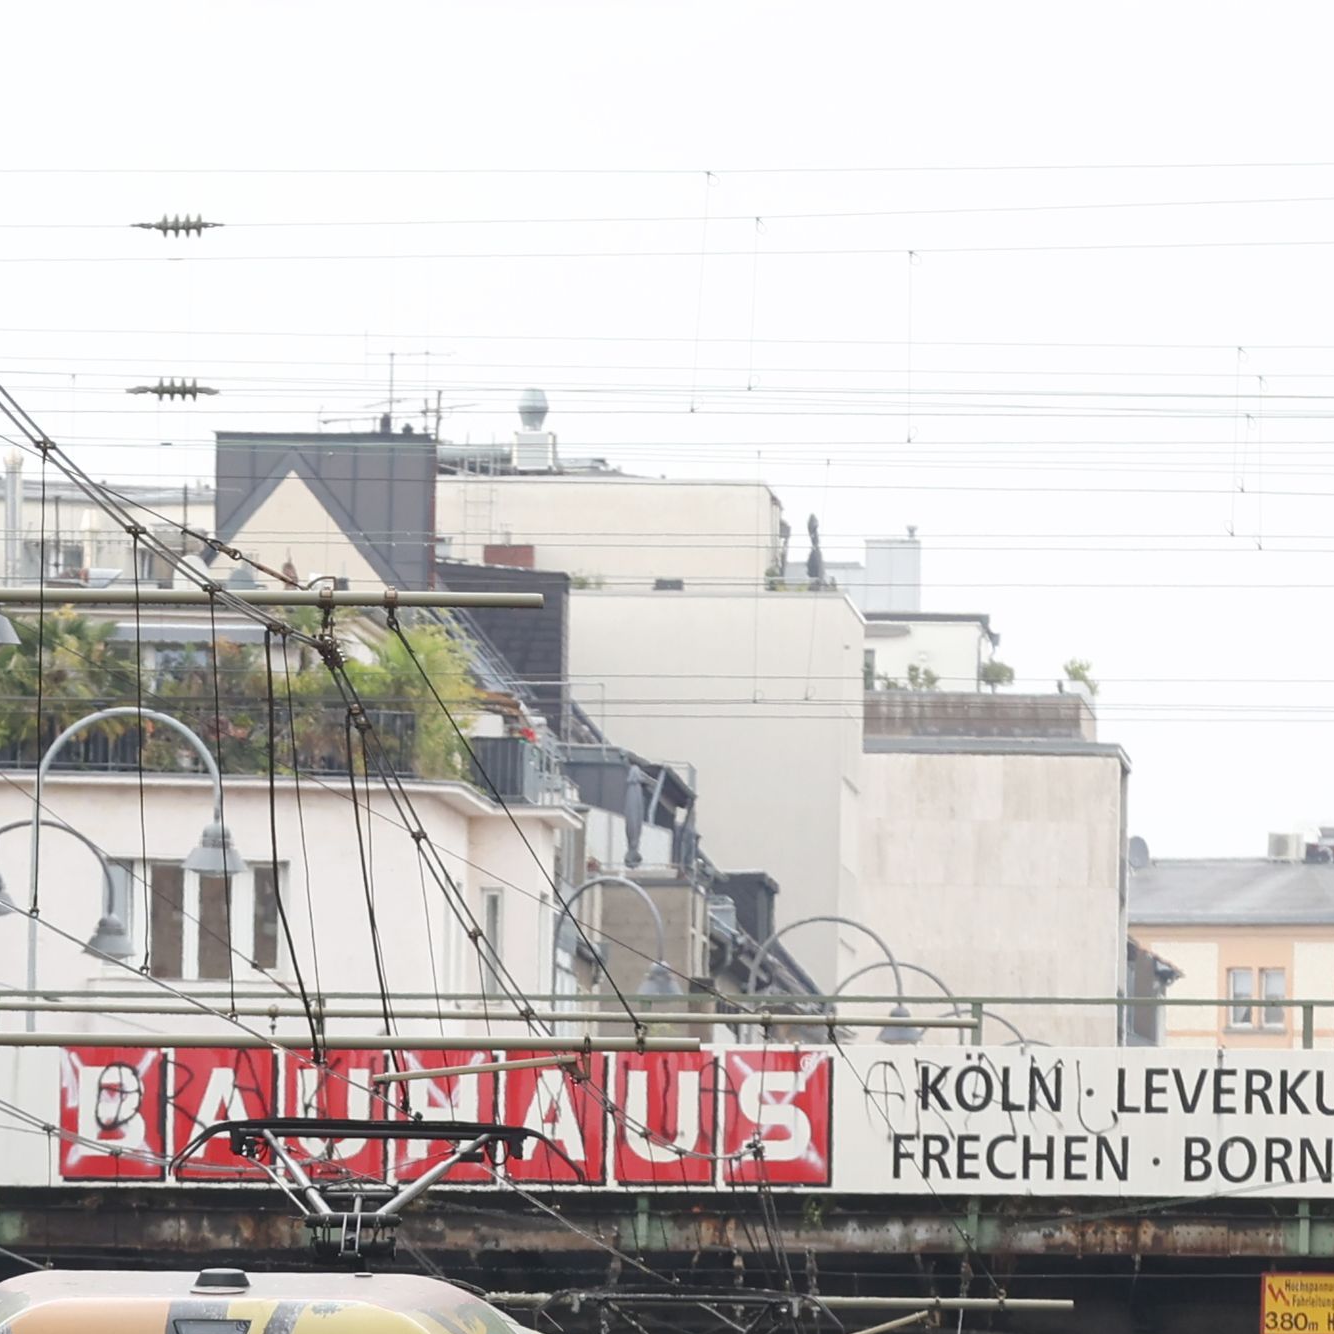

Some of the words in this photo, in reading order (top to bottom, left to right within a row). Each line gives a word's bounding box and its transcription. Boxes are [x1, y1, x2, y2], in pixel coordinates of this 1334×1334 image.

[921, 1053, 1063, 1113] KÖLN
[77, 1066, 813, 1162] BAUHAUS
[892, 1133, 1130, 1181] FRECHEN
